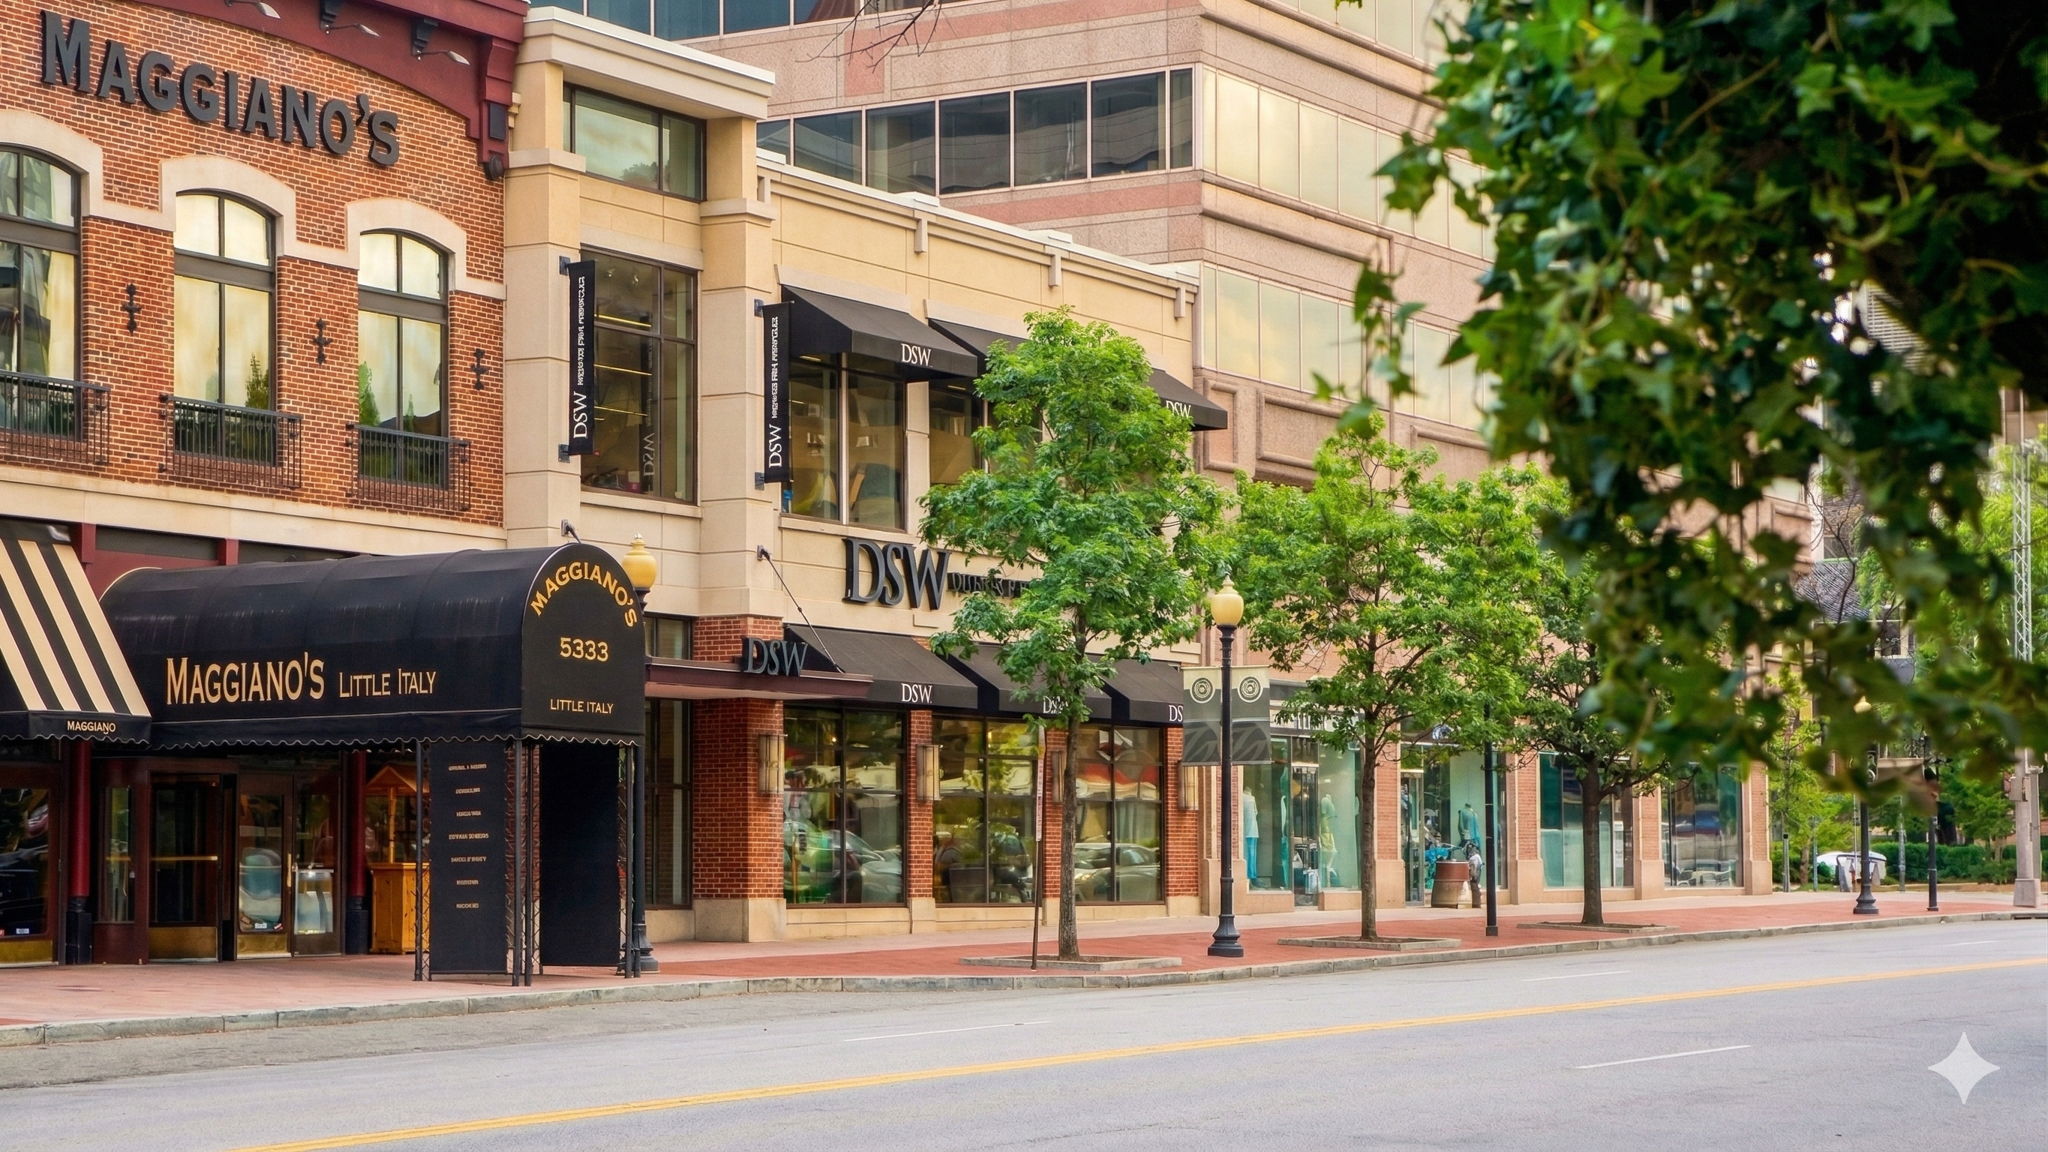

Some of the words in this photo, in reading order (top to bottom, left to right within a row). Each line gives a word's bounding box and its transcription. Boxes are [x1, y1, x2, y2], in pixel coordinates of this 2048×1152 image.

[41, 10, 400, 167] MAGGIANO'S
[901, 343, 932, 367] DSW
[573, 393, 587, 438] DSW
[769, 424, 782, 468] DSW
[530, 561, 638, 627] MAGGIANO'S
[842, 537, 950, 610] DSW
[560, 637, 609, 662] 5333
[743, 635, 808, 677] DSW
[550, 698, 584, 713] LITTLE
[587, 701, 614, 714] ITALY
[901, 683, 932, 703] DSW
